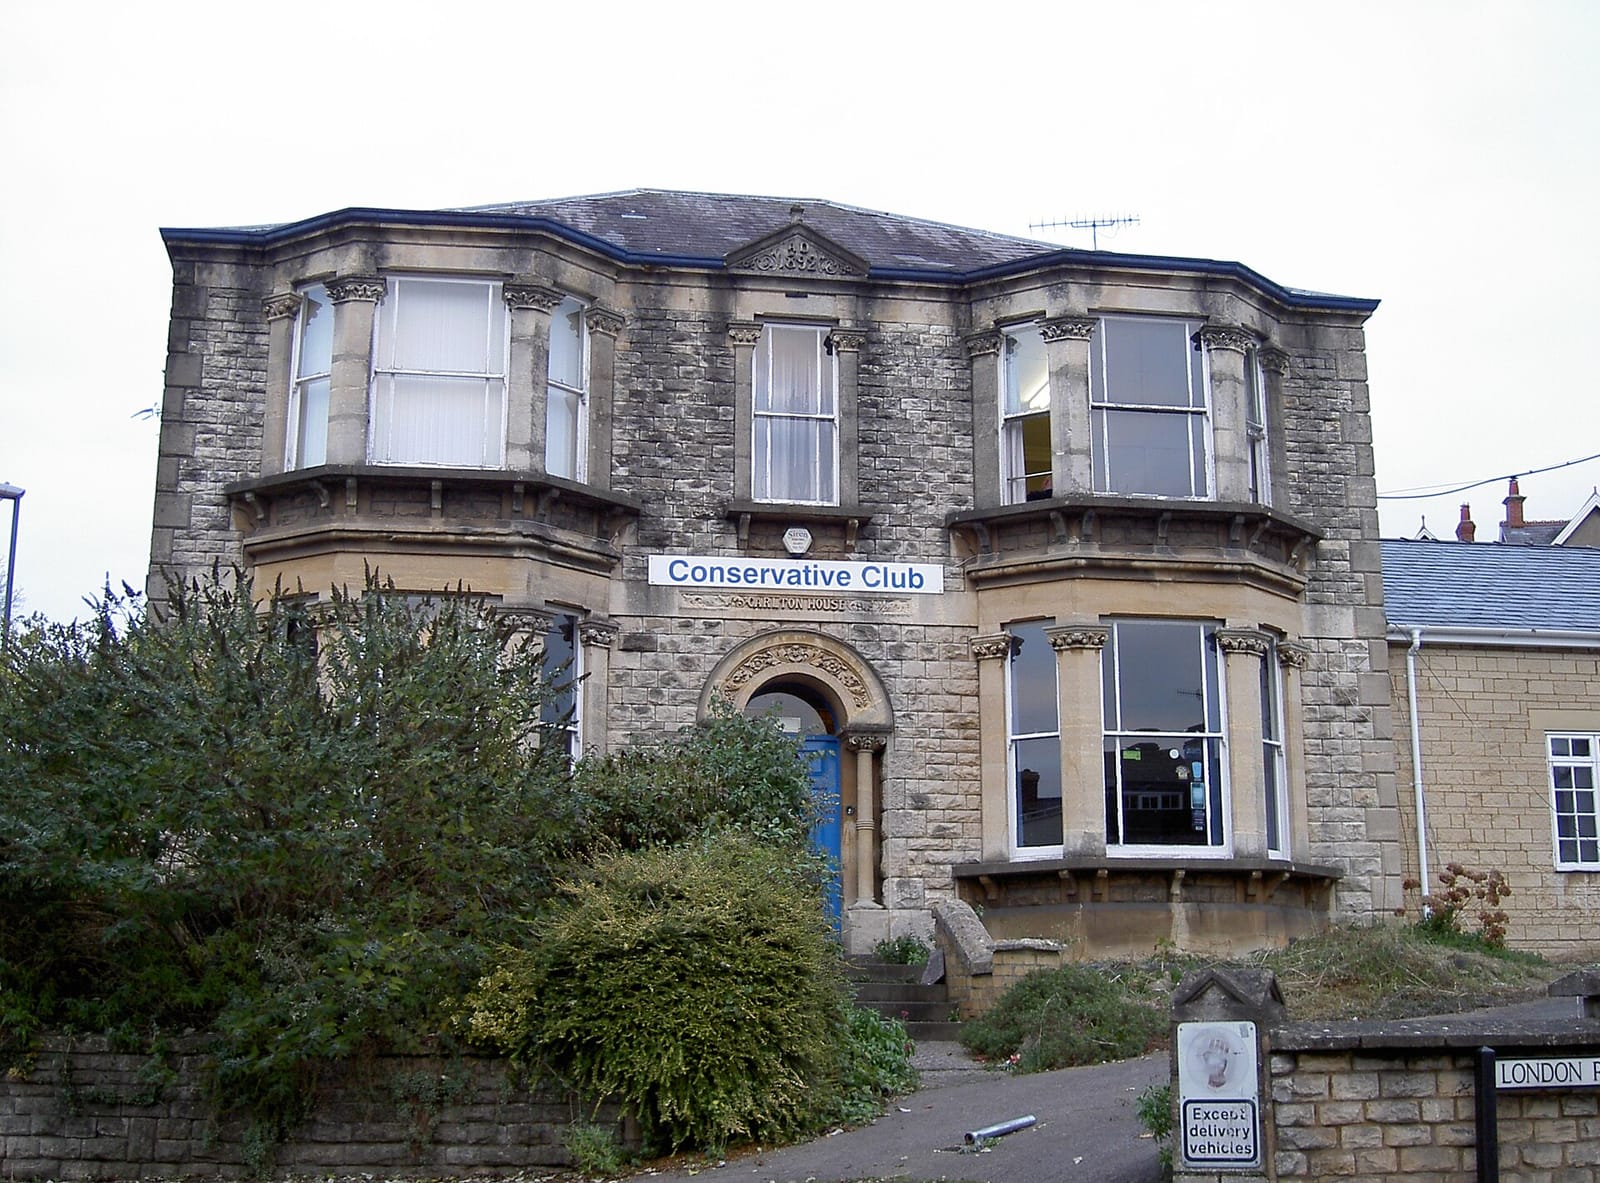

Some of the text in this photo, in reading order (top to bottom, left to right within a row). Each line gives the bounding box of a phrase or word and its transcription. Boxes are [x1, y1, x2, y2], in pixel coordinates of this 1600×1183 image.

[669, 559, 924, 589] Conservative Club
[748, 597, 845, 611] CARLTON HOUSE
[1502, 1061, 1582, 1084] LONDON
[1193, 1107, 1246, 1120] Except
[1190, 1124, 1250, 1140] delivery
[1190, 1142, 1252, 1154] vehicles
